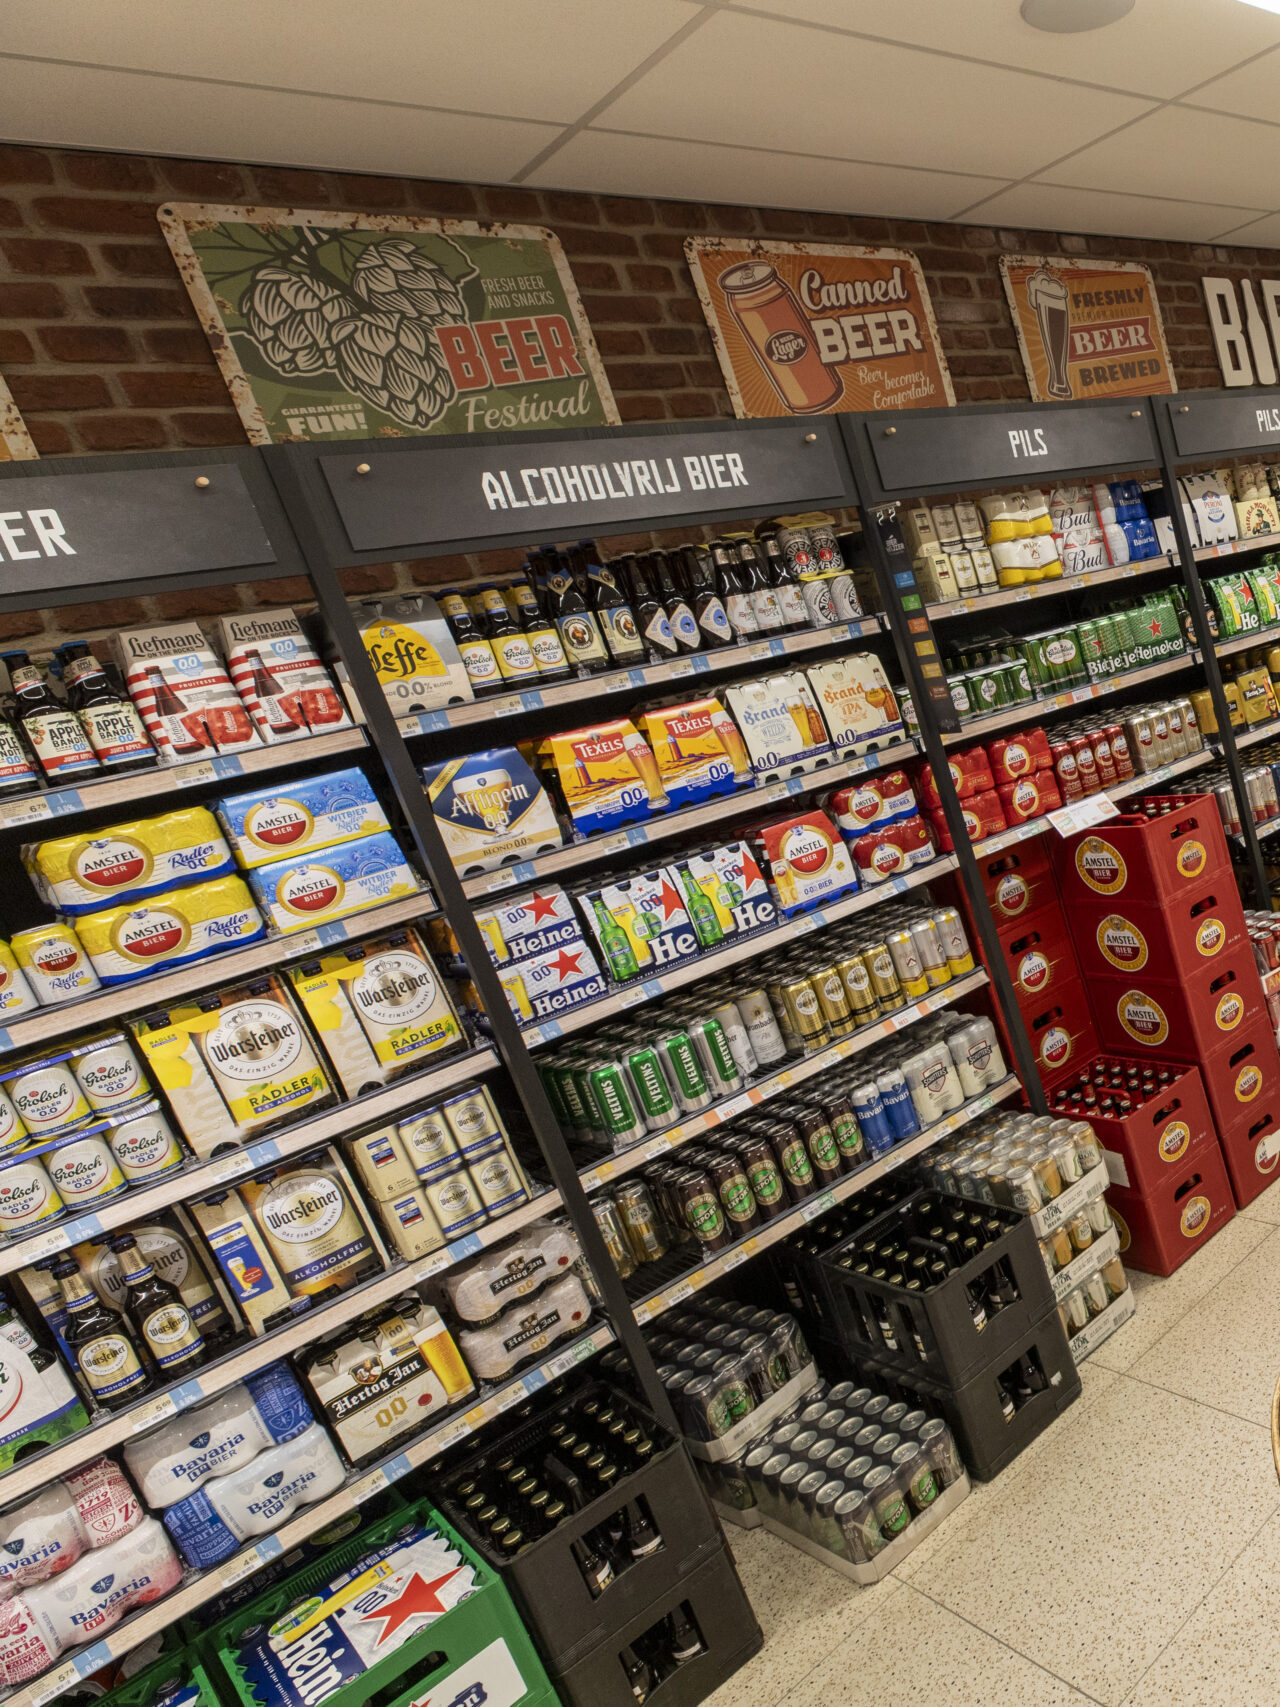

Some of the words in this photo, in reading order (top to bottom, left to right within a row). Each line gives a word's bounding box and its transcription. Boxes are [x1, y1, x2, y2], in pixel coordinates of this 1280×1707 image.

[481, 279, 516, 295] FRESH
[518, 275, 545, 291] BEER
[800, 267, 907, 313] Canned
[488, 294, 510, 309] AND
[513, 291, 555, 307] SNACKS
[1072, 288, 1144, 308] FRESHLY
[772, 337, 805, 362] Lager
[810, 309, 926, 367] BEER
[1072, 325, 1150, 355] BEER
[436, 315, 588, 391] BEER
[858, 367, 883, 385] Beer
[883, 370, 925, 390] becomes
[1079, 358, 1161, 386] BREWED
[457, 380, 592, 433] Festival
[873, 382, 936, 409] Comfortable
[281, 402, 363, 417] GUARANTEED
[1256, 409, 1280, 432] PILS
[287, 411, 366, 434] FUN!
[1008, 429, 1048, 458] PILS
[482, 458, 681, 510] ALCOHOLVRIJ
[683, 453, 749, 490] BIER
[1203, 500, 1222, 508] PERONI
[1060, 507, 1092, 530] Bud
[1071, 549, 1103, 573] Bud
[230, 618, 300, 642] Liefmans
[128, 633, 205, 657] Liefmans
[174, 646, 196, 655] ROCKS
[368, 638, 427, 677] Leffe
[276, 662, 310, 672] FRUITESSE
[179, 678, 217, 689] FRUITESSE
[824, 683, 865, 704] Brand
[96, 716, 133, 732] APPLE
[667, 714, 711, 734] TEXELS
[744, 703, 789, 726] Brand
[99, 726, 135, 740] BANDIT
[575, 738, 624, 758] TEXELS
[451, 784, 530, 818] Affligem
[328, 808, 368, 823] WITBIER
[168, 845, 214, 868] Radler
[1084, 856, 1117, 869] AMSTEL
[289, 879, 333, 898] AMSTEL
[358, 871, 397, 888] WITBIER
[125, 921, 177, 943] AMSTEL
[205, 913, 249, 937] Radler
[1105, 932, 1139, 945] AMSTEL
[357, 972, 430, 1008] Warsteiner
[211, 1022, 296, 1063] Warsteiner
[391, 1022, 442, 1050] RADLER
[229, 1065, 244, 1073] DAS
[247, 1063, 277, 1074] EINZIG
[279, 1041, 294, 1062] WAHRE
[712, 1029, 736, 1072] VELTINS
[678, 1044, 700, 1086] VELTINS
[250, 1077, 310, 1107] RADLER
[600, 1078, 624, 1120] VELTINS
[116, 1132, 164, 1158] Grolsch
[52, 1156, 103, 1183] Grolsch
[268, 1189, 339, 1231] Warsteiner
[728, 1186, 752, 1212] EXPORT
[694, 1208, 719, 1235] EXPORT
[294, 1242, 364, 1280] ALKOHOLFREI
[332, 1375, 389, 1418] Hertog
[391, 1358, 421, 1387] Jan
[171, 1433, 245, 1479] Bavaria
[246, 1470, 317, 1515] Bavaria
[70, 1575, 151, 1626] Bavaria
